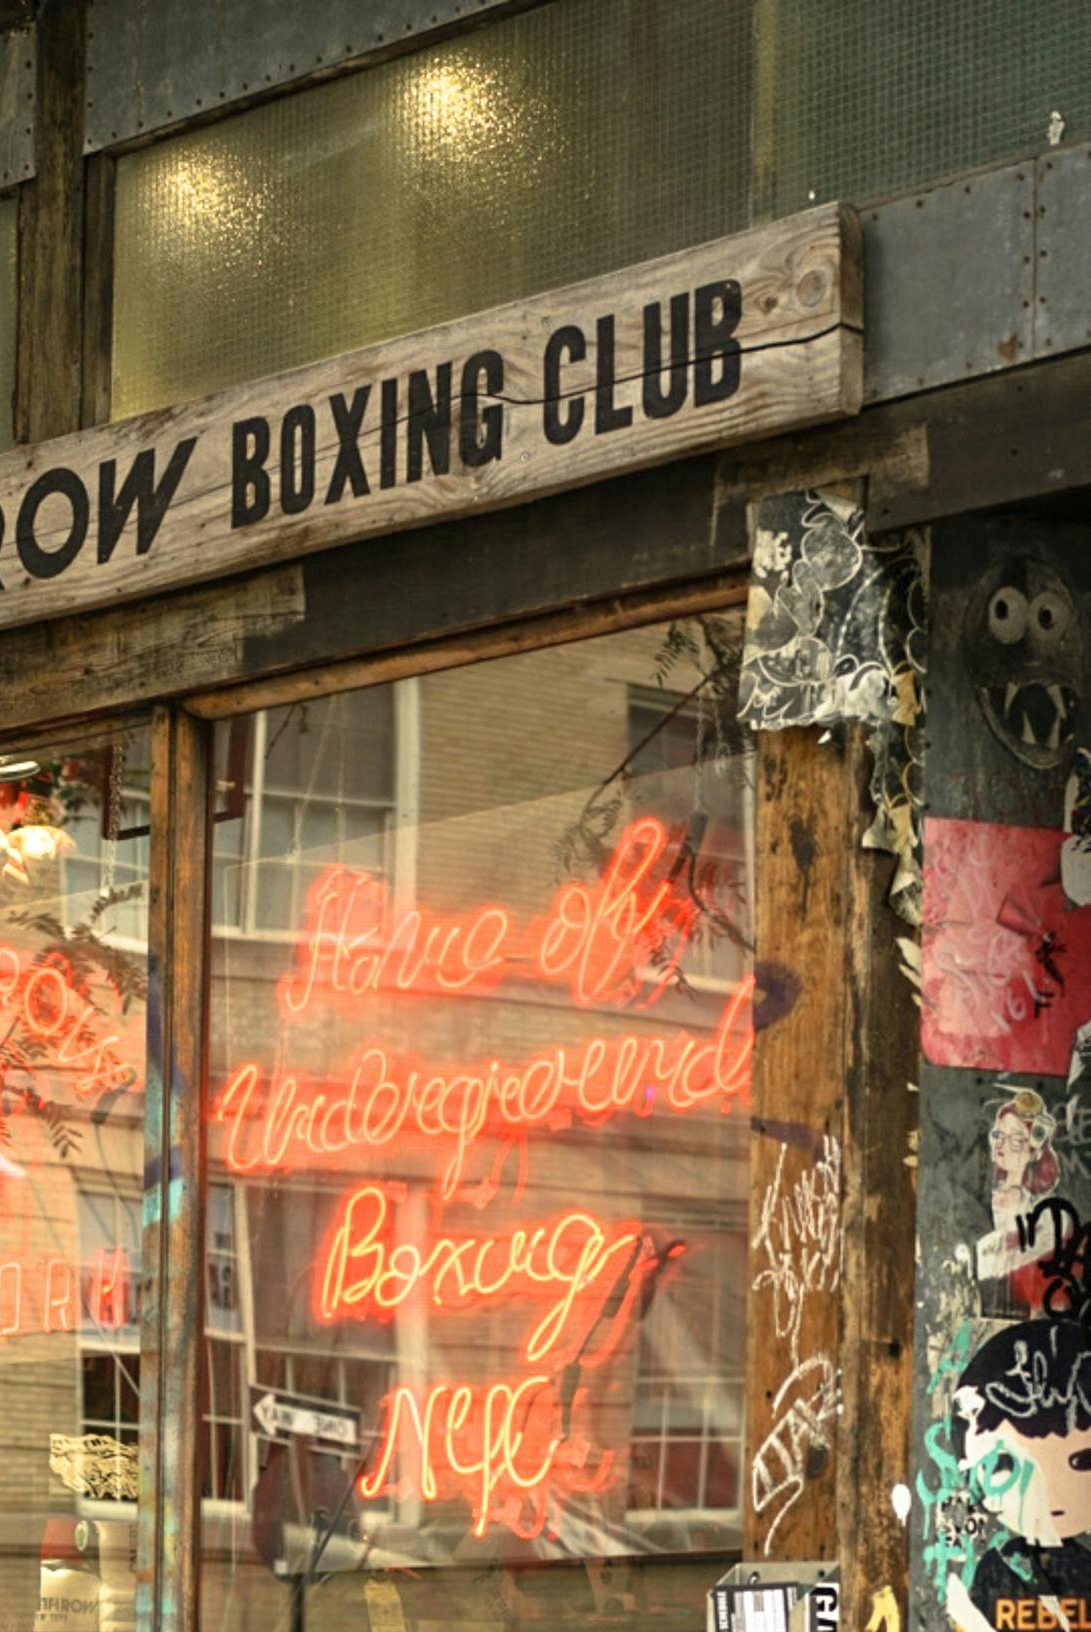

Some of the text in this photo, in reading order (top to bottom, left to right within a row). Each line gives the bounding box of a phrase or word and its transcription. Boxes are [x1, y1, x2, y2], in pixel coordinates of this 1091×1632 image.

[231, 349, 504, 530] BOXING
[543, 279, 742, 446] CLUB
[319, 1183, 638, 1361] Boxing
